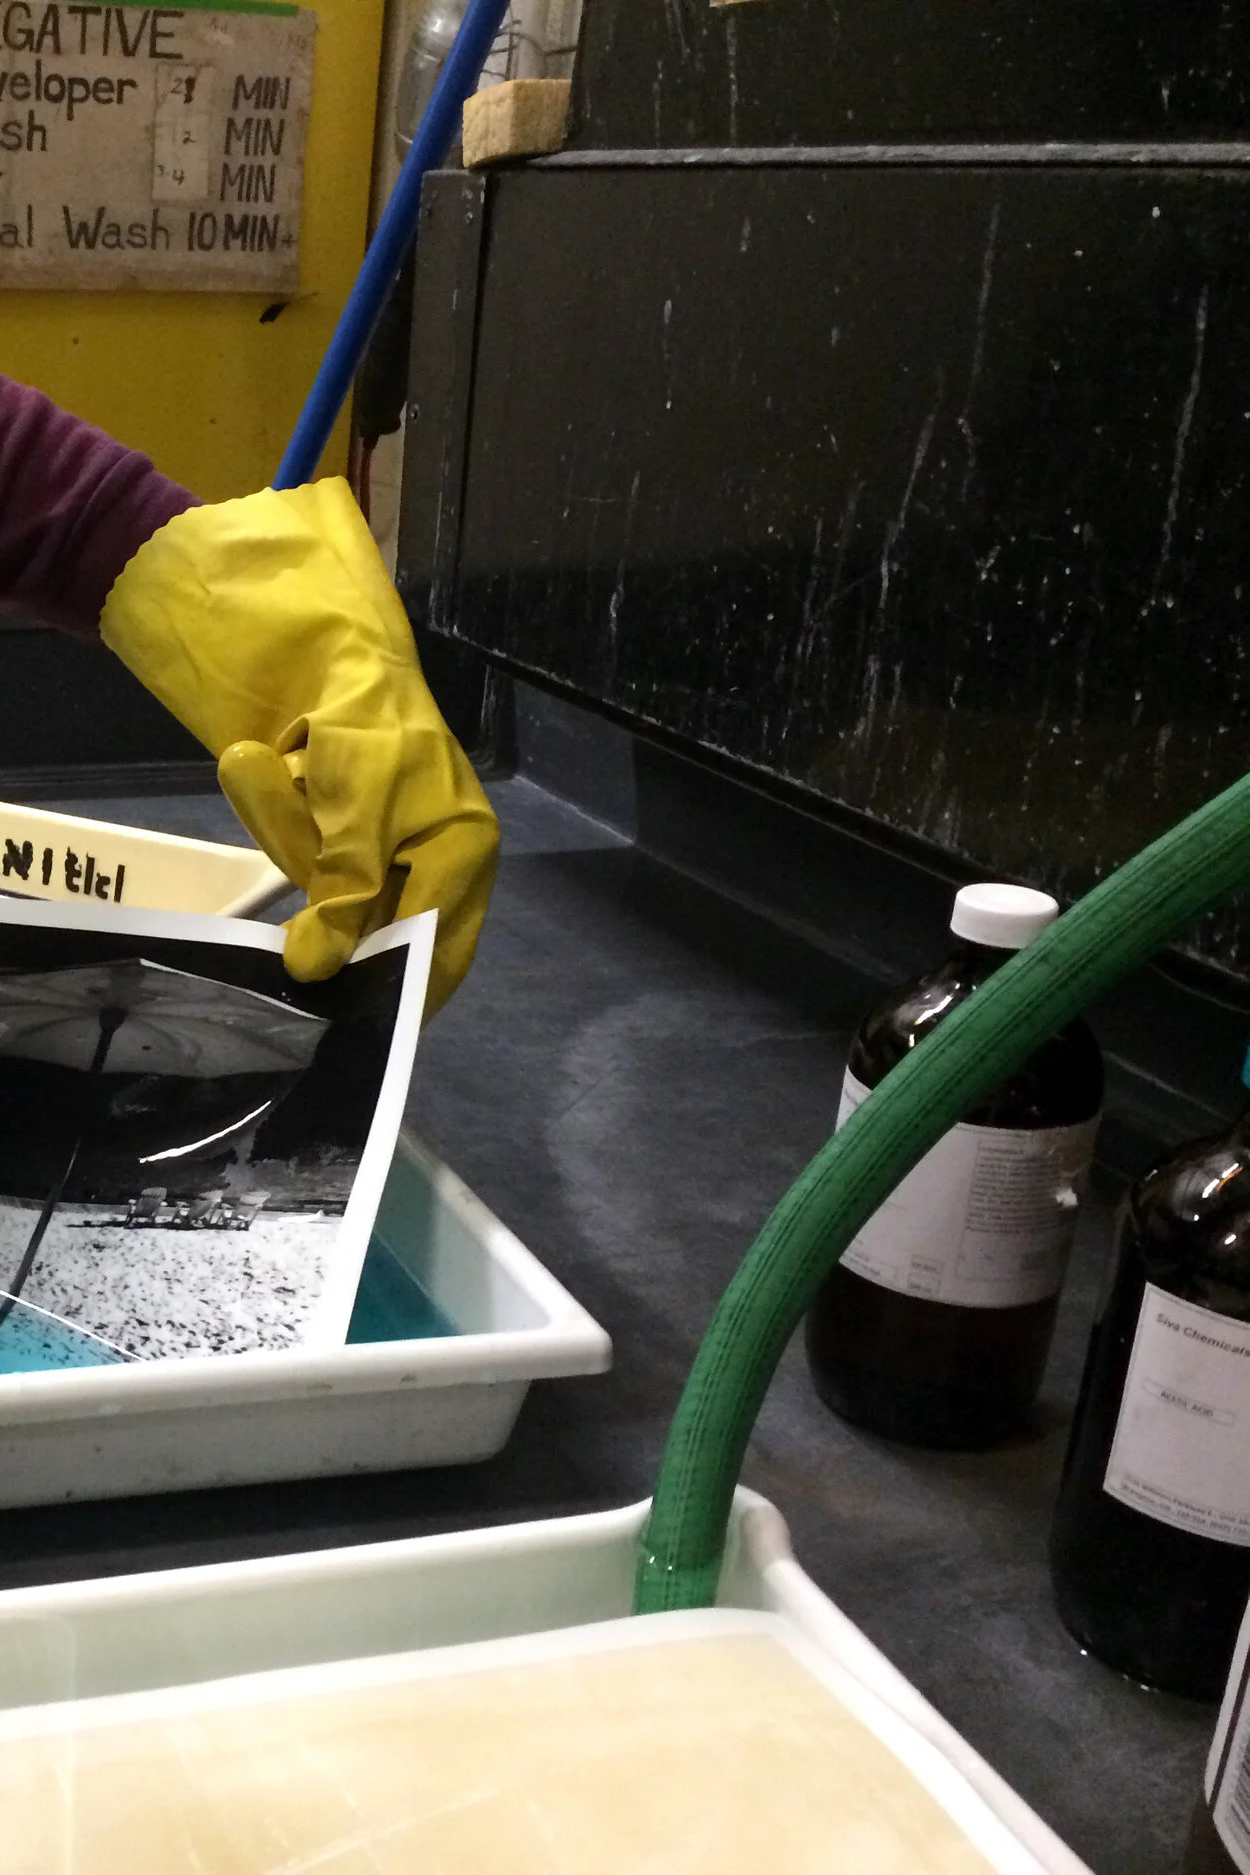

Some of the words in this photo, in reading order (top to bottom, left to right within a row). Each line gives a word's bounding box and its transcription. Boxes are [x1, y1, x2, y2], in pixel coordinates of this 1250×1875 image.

[232, 74, 291, 110] MIN
[224, 117, 285, 156] MIN
[220, 161, 277, 203] MIN
[62, 205, 170, 250] Wash
